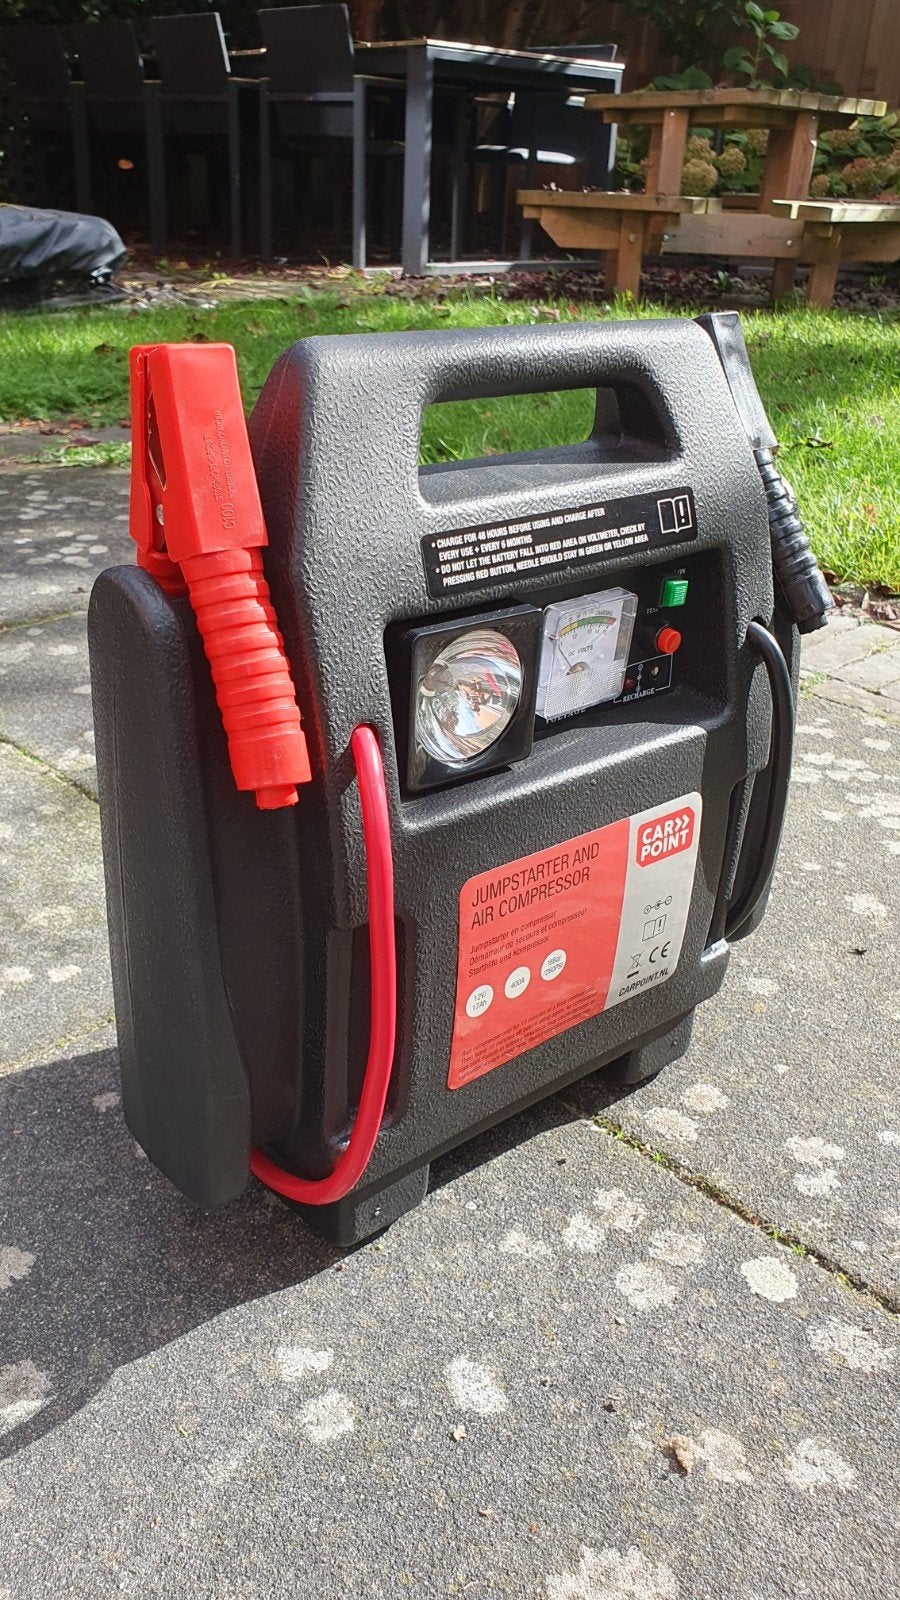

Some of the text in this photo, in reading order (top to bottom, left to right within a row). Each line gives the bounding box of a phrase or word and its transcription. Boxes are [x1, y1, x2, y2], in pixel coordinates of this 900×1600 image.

[220, 502, 236, 529] C100
[437, 508, 605, 548] CHARGE FOR 48 HOURS BEFORE USING AND CHARGE AFTER
[439, 549, 459, 561] EVERY
[460, 546, 474, 556] USE
[480, 541, 500, 553] EVERY
[501, 540, 506, 548] 6
[506, 535, 532, 547] MONTHS
[441, 523, 645, 574] DO NOT LET THE BATTERY FALL INTO RED AREA ON VOLTMETER, CHECK BY
[443, 534, 648, 587] PRESSING RED BUTTON, NEEDLE SHOULD STAY IN GREEN OR YELLOW AREA
[578, 644, 594, 654] VOLTS
[623, 688, 655, 702] RECHARGE
[640, 828, 690, 862] POINT
[642, 819, 674, 844] CAR
[472, 842, 599, 907] JUMPSTARTER AND
[471, 866, 590, 930] AIR COMPRESSOR
[470, 910, 557, 954] Jumpstarter en compressor
[506, 940, 514, 949] de
[516, 930, 540, 945] secours
[541, 924, 547, 933] et
[548, 908, 588, 931] compresseur
[469, 935, 550, 977] Starthilfe und Kompressor
[511, 977, 525, 988] 400A
[618, 966, 669, 996] CARPOINT.NL
